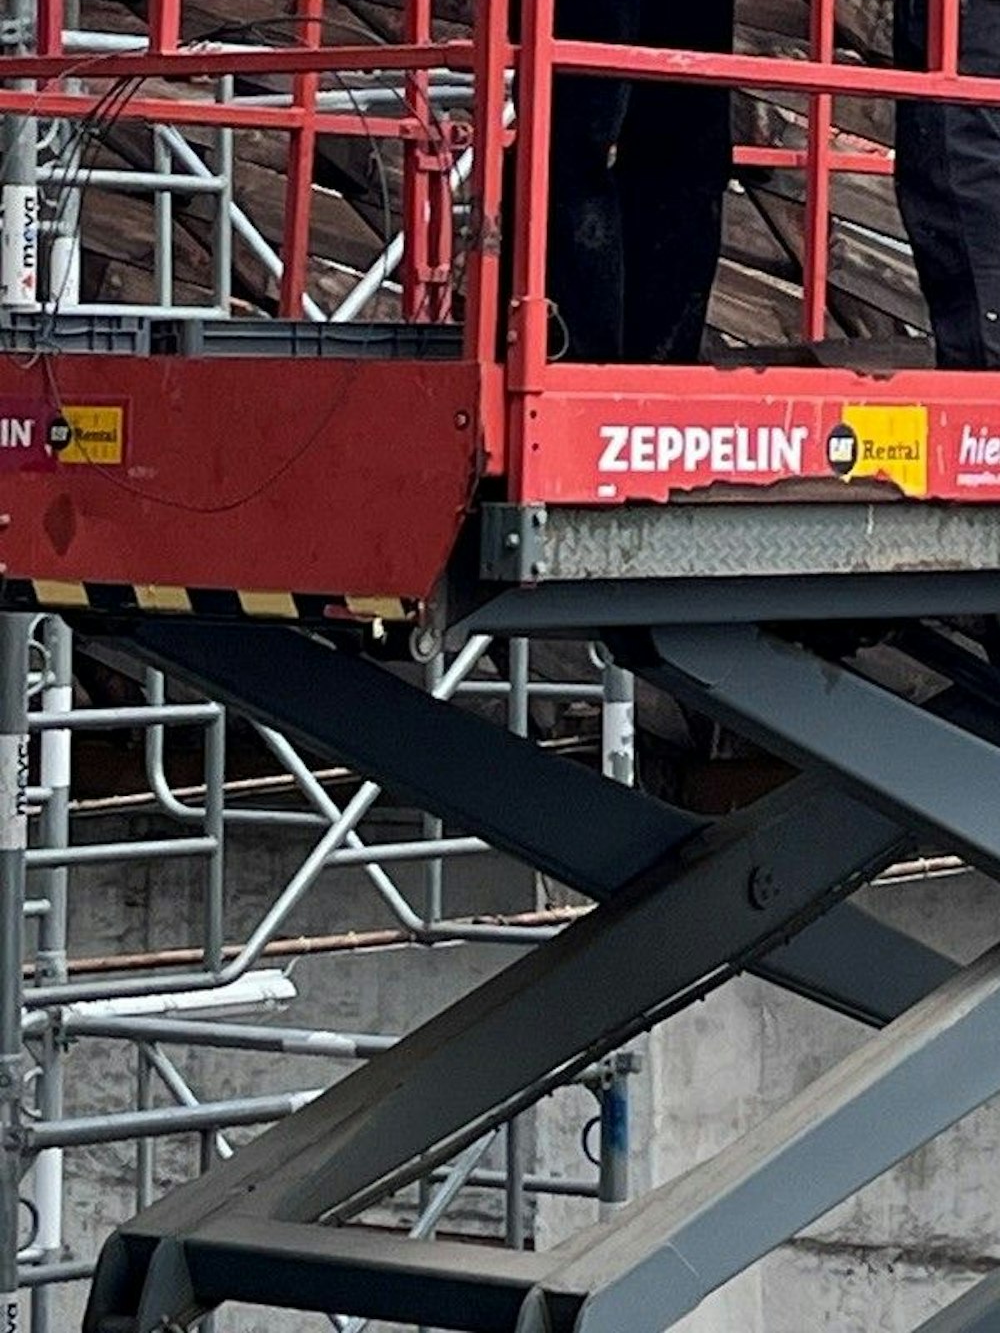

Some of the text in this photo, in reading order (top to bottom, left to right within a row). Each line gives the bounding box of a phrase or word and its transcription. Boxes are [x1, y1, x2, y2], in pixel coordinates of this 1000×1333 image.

[0, 418, 32, 448] IN
[598, 425, 803, 474] ZEPPELIN
[862, 439, 921, 461] Rental
